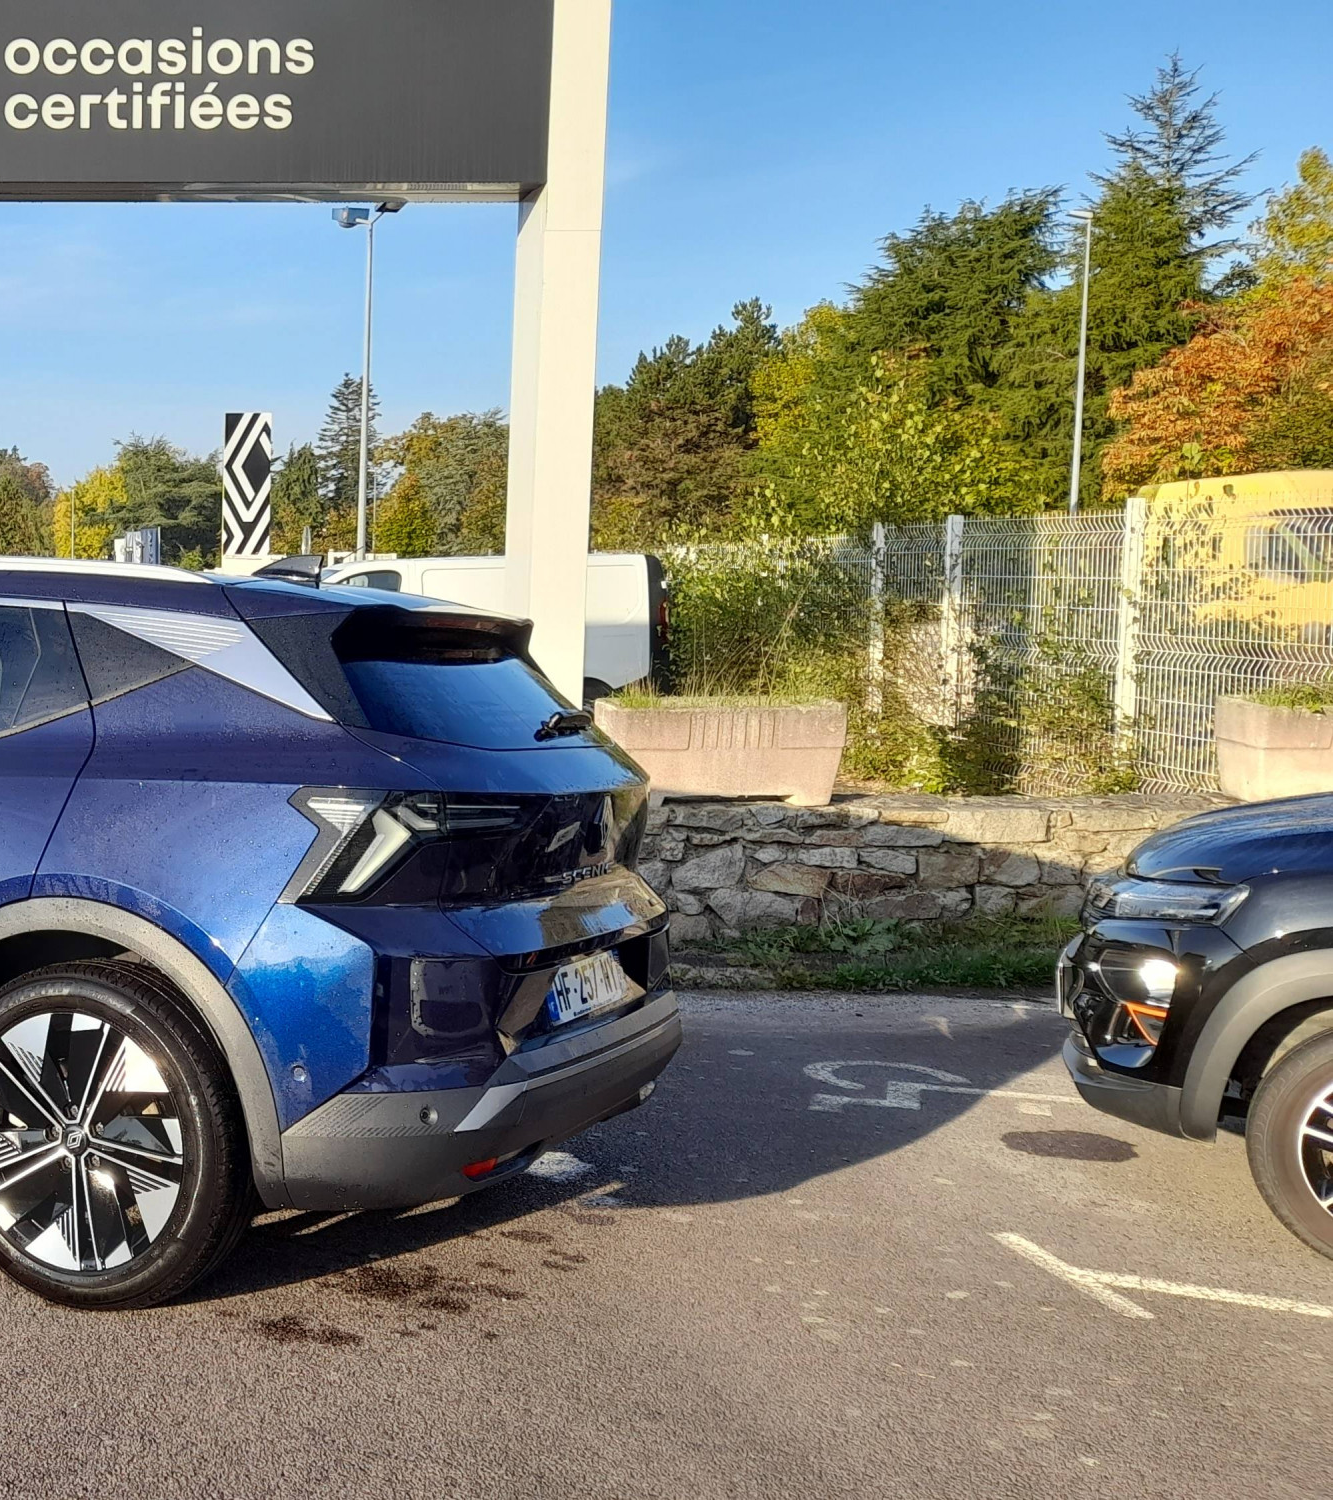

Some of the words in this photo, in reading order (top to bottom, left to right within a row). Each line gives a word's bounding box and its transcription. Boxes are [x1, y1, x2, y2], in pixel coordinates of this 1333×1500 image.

[4, 26, 314, 75] occasions
[4, 81, 293, 129] certifiées
[562, 861, 614, 884] SCENIC
